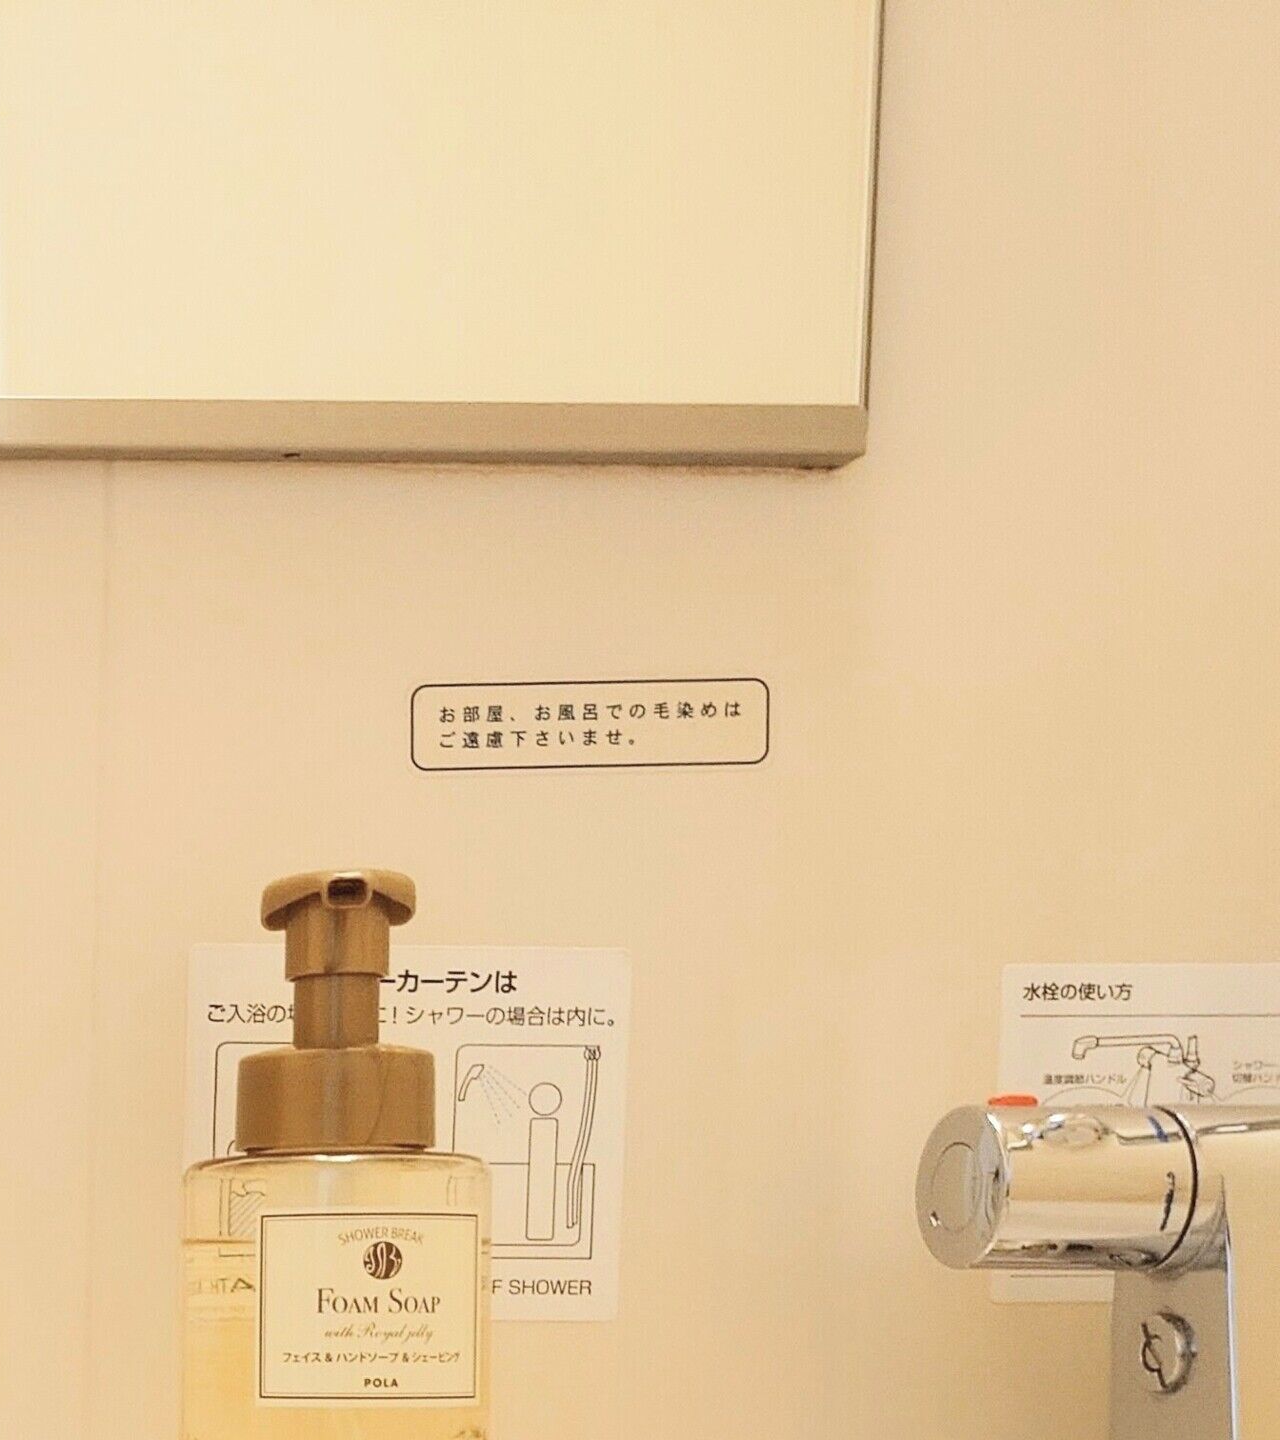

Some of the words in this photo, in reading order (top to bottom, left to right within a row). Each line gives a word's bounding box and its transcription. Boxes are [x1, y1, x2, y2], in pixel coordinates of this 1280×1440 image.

[1022, 982, 1133, 1003] 水栓の使い方
[337, 1227, 389, 1245] SHOWER
[390, 1227, 425, 1245] BREAK
[508, 1279, 592, 1296] SHOWER
[363, 1377, 399, 1389] POLA
